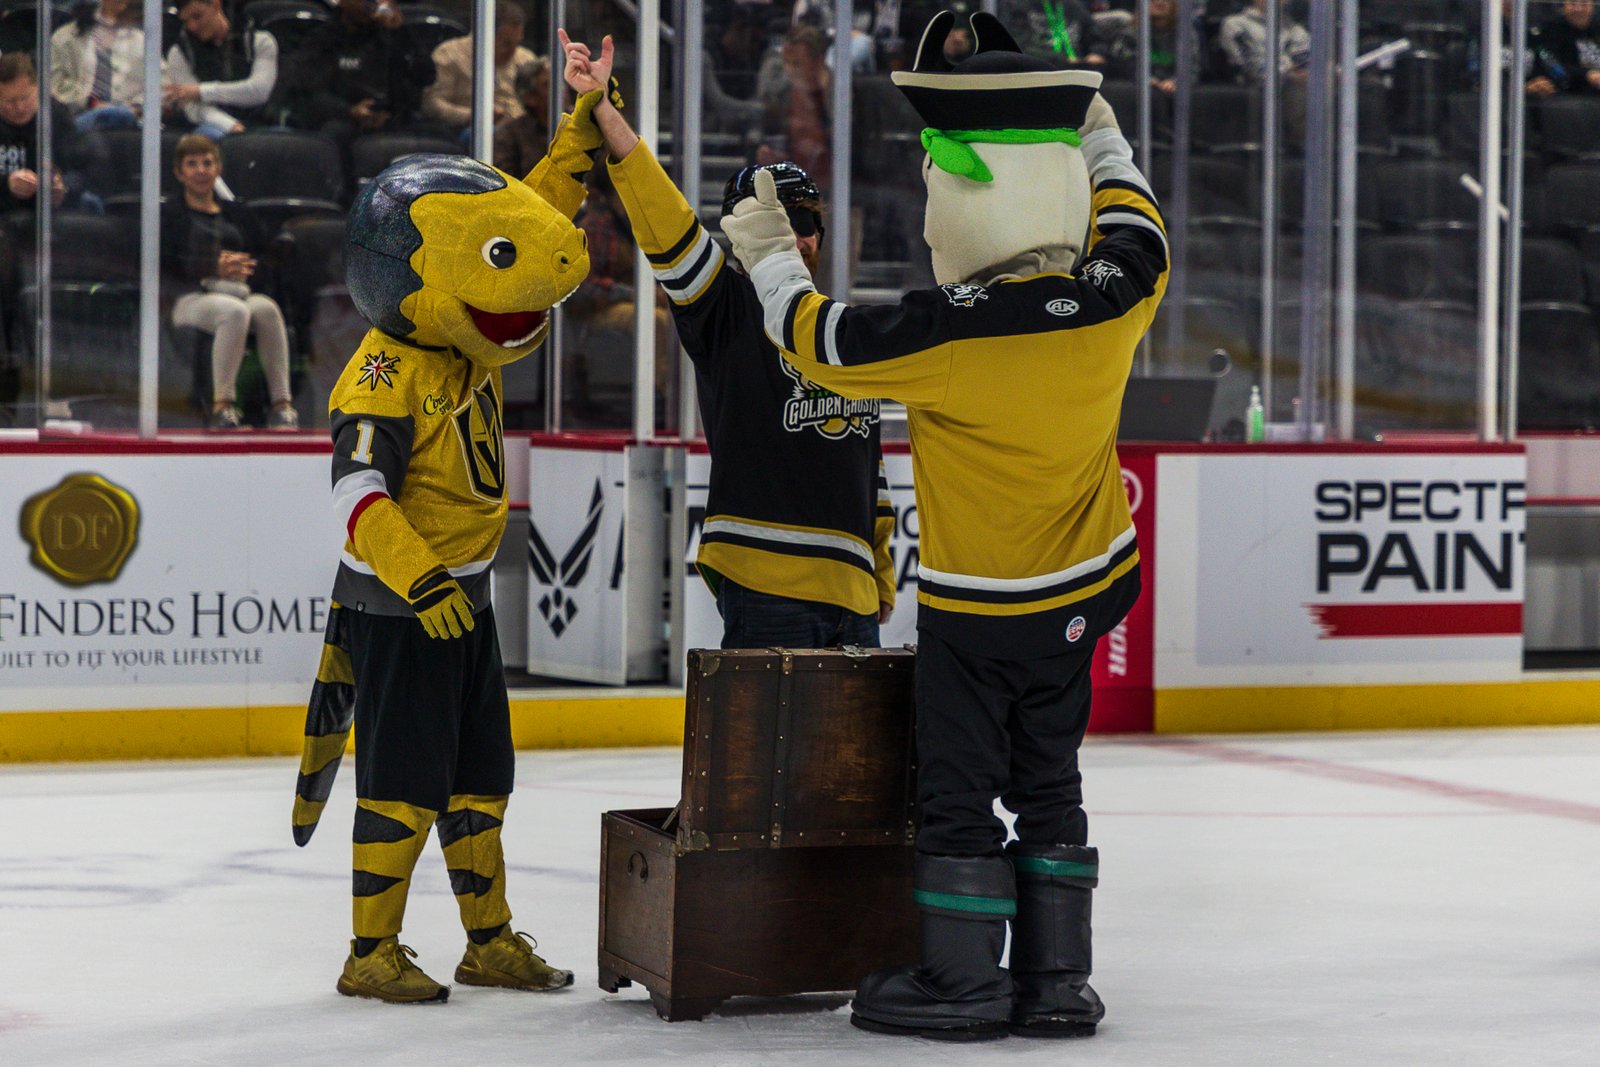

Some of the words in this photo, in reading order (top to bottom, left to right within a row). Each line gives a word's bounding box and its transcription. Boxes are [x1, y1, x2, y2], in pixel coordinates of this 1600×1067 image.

[351, 420, 375, 465] 1
[51, 512, 113, 550] DF
[1316, 531, 1525, 592] PAIN
[0, 651, 35, 668] UILT
[44, 651, 70, 668] TO
[111, 650, 167, 667] YOUR
[173, 649, 264, 666] LIFESTYLE
